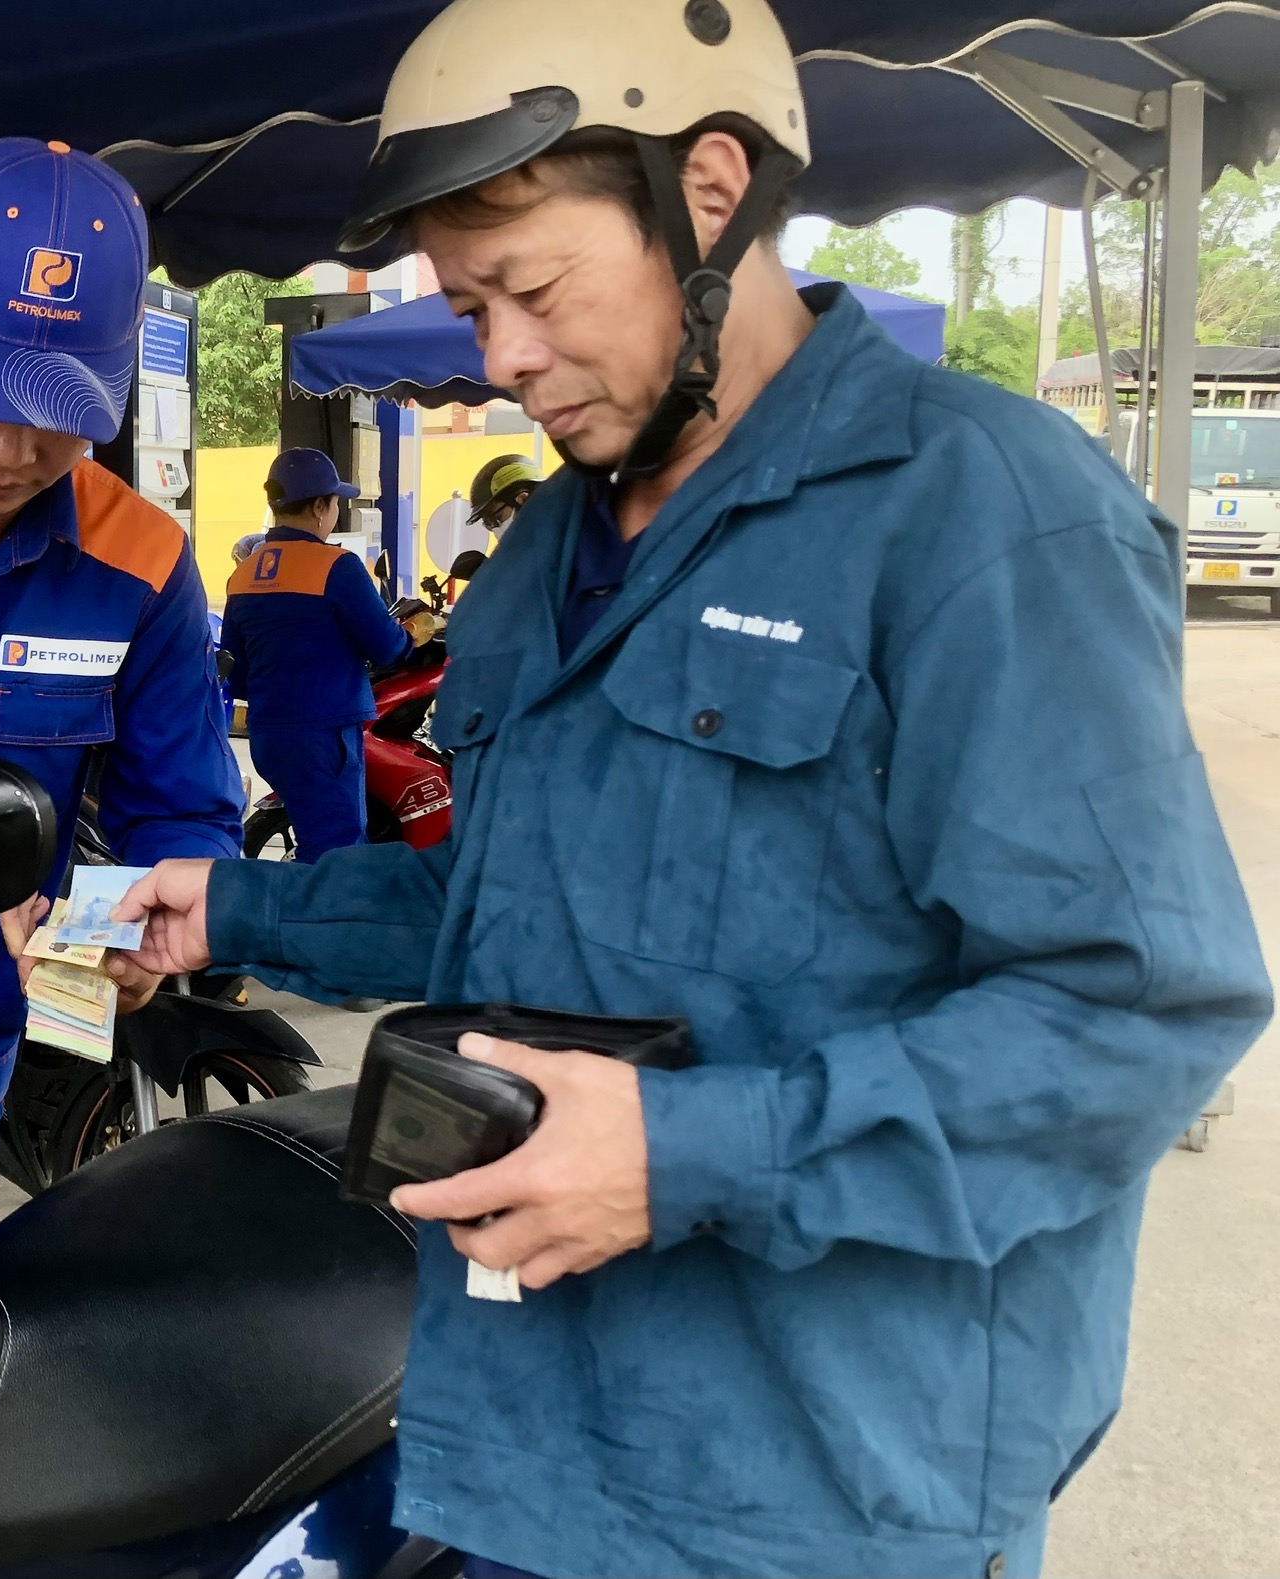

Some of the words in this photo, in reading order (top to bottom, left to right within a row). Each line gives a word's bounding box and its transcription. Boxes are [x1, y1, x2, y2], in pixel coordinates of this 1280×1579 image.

[7, 299, 82, 321] PETROLIMEX
[1204, 520, 1247, 529] ISUZU
[29, 650, 123, 664] PETROLIMEX
